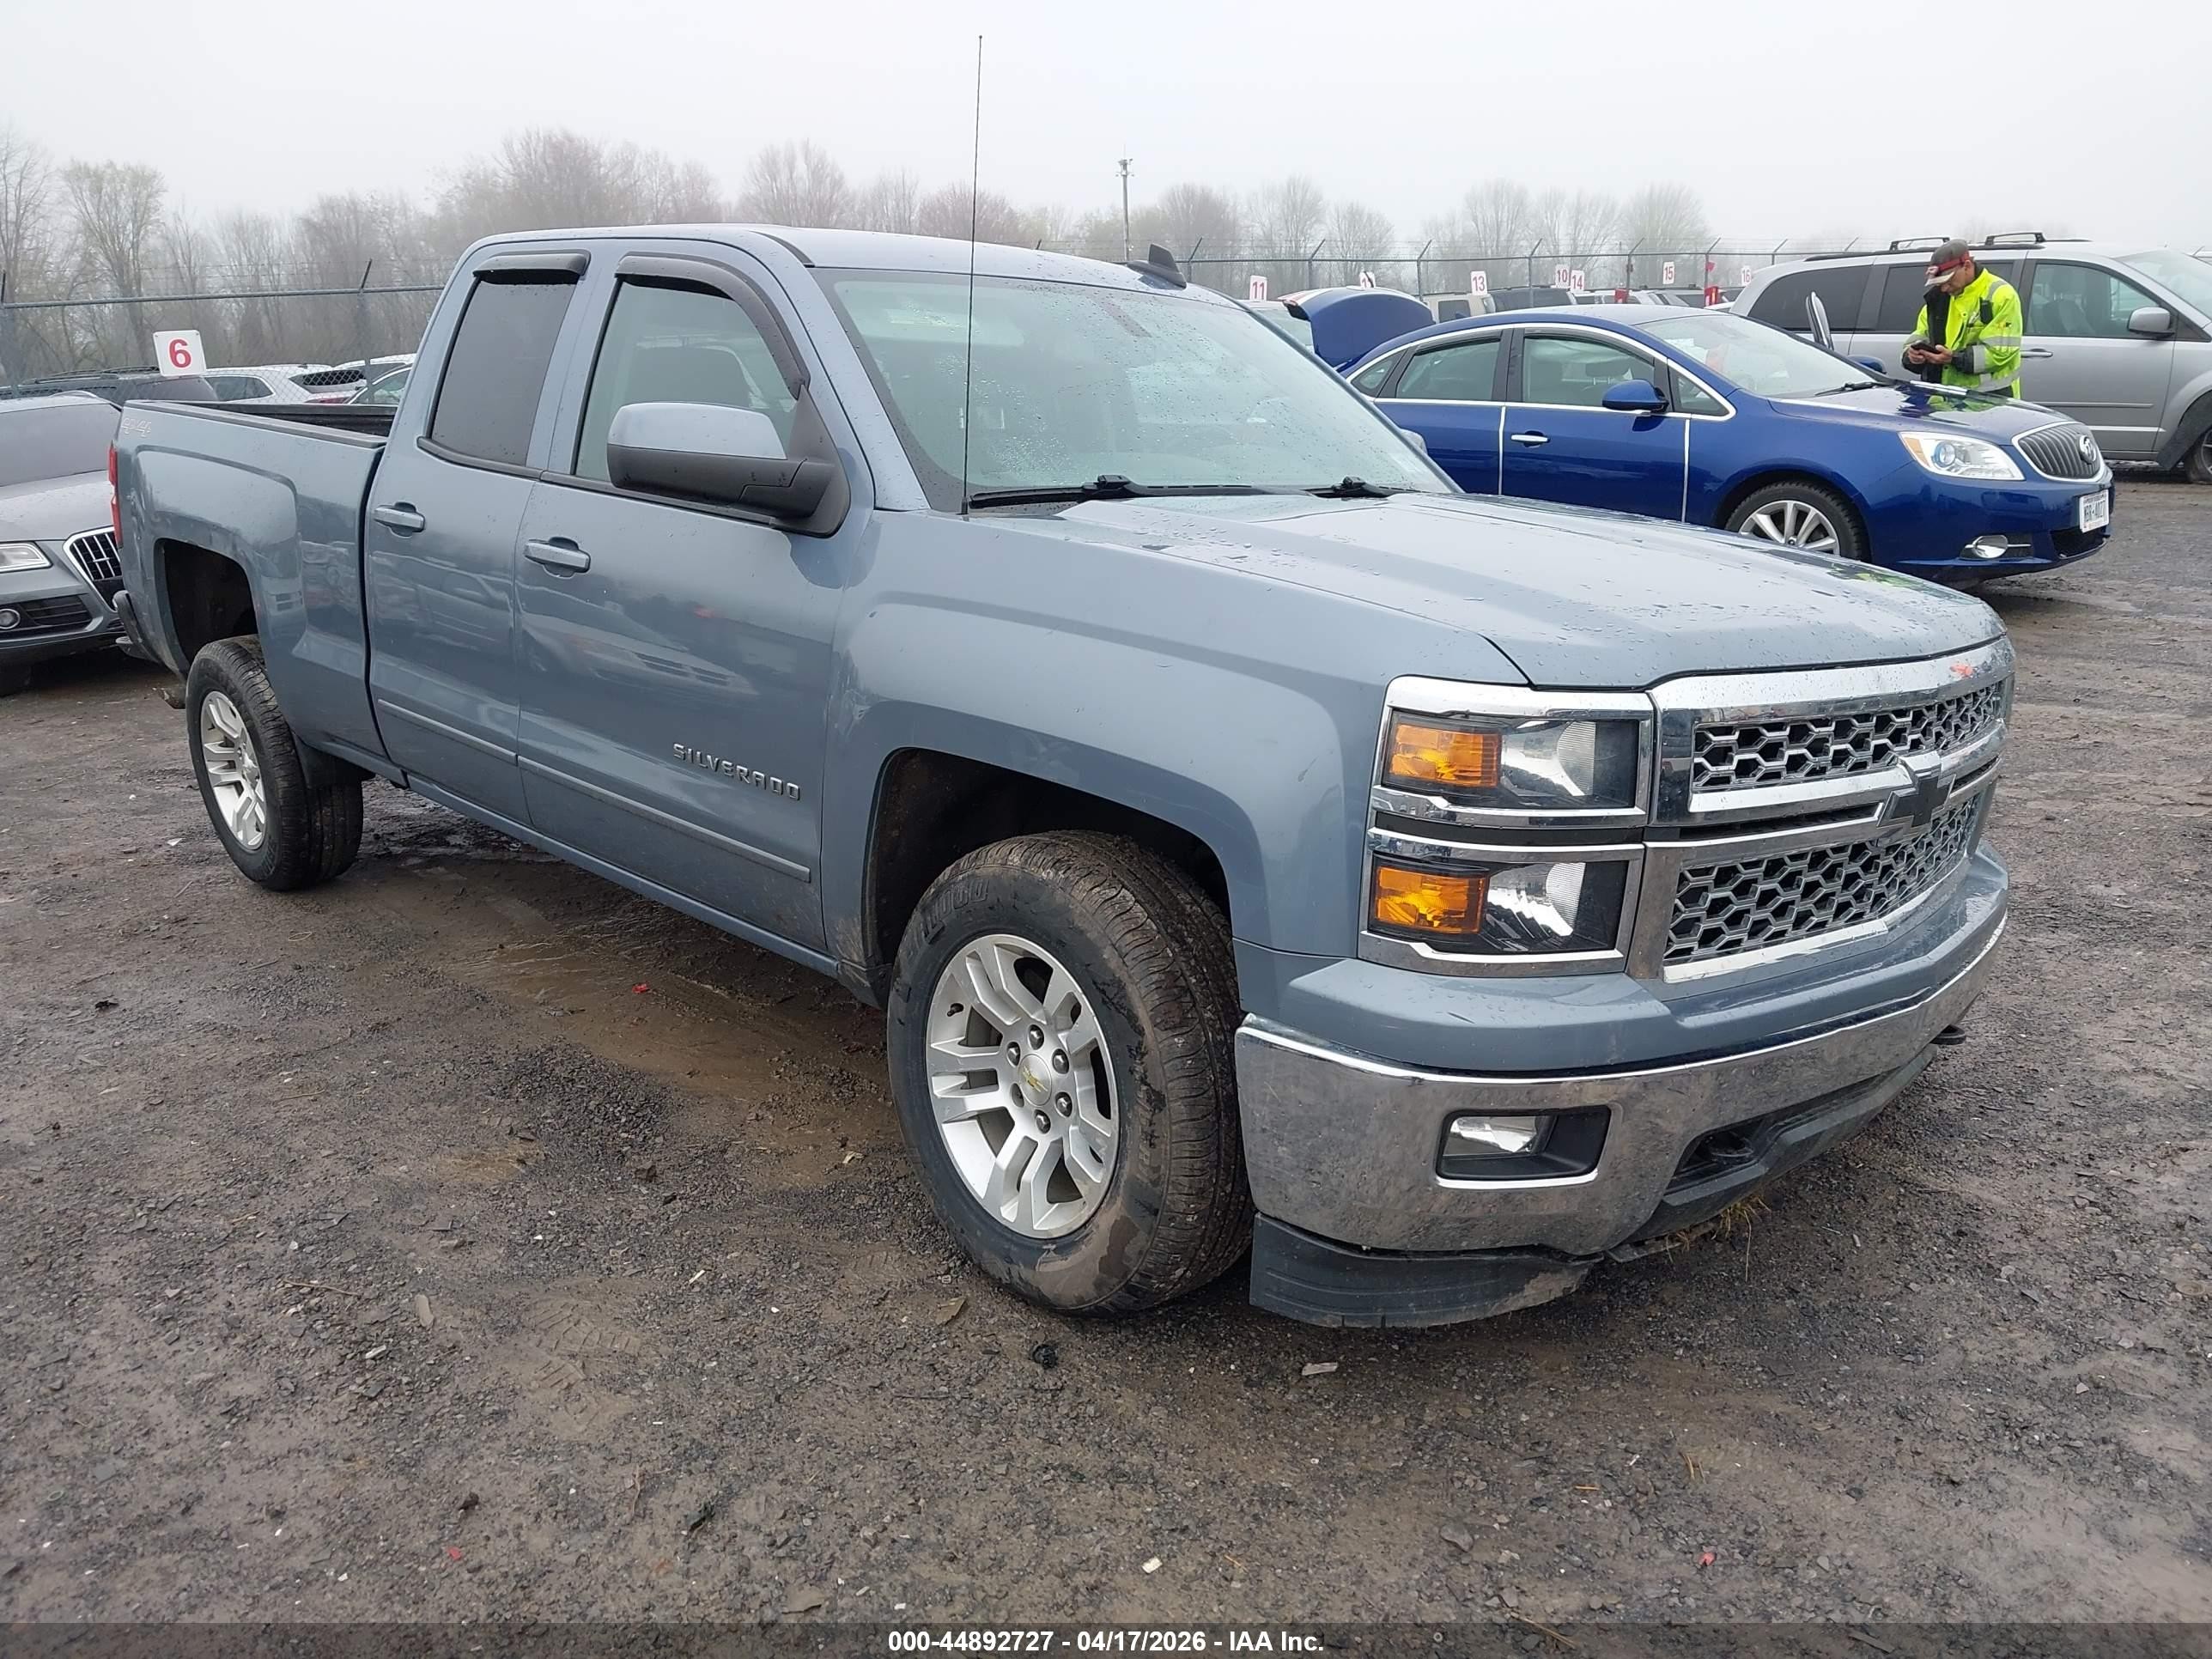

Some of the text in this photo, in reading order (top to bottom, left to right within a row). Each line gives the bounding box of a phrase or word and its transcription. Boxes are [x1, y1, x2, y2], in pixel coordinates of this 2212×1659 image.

[1252, 281, 1265, 299] 11
[1472, 276, 1486, 292] 13
[1571, 275, 1583, 290] 14
[168, 338, 191, 368] 6
[672, 742, 801, 801] SILVERADO
